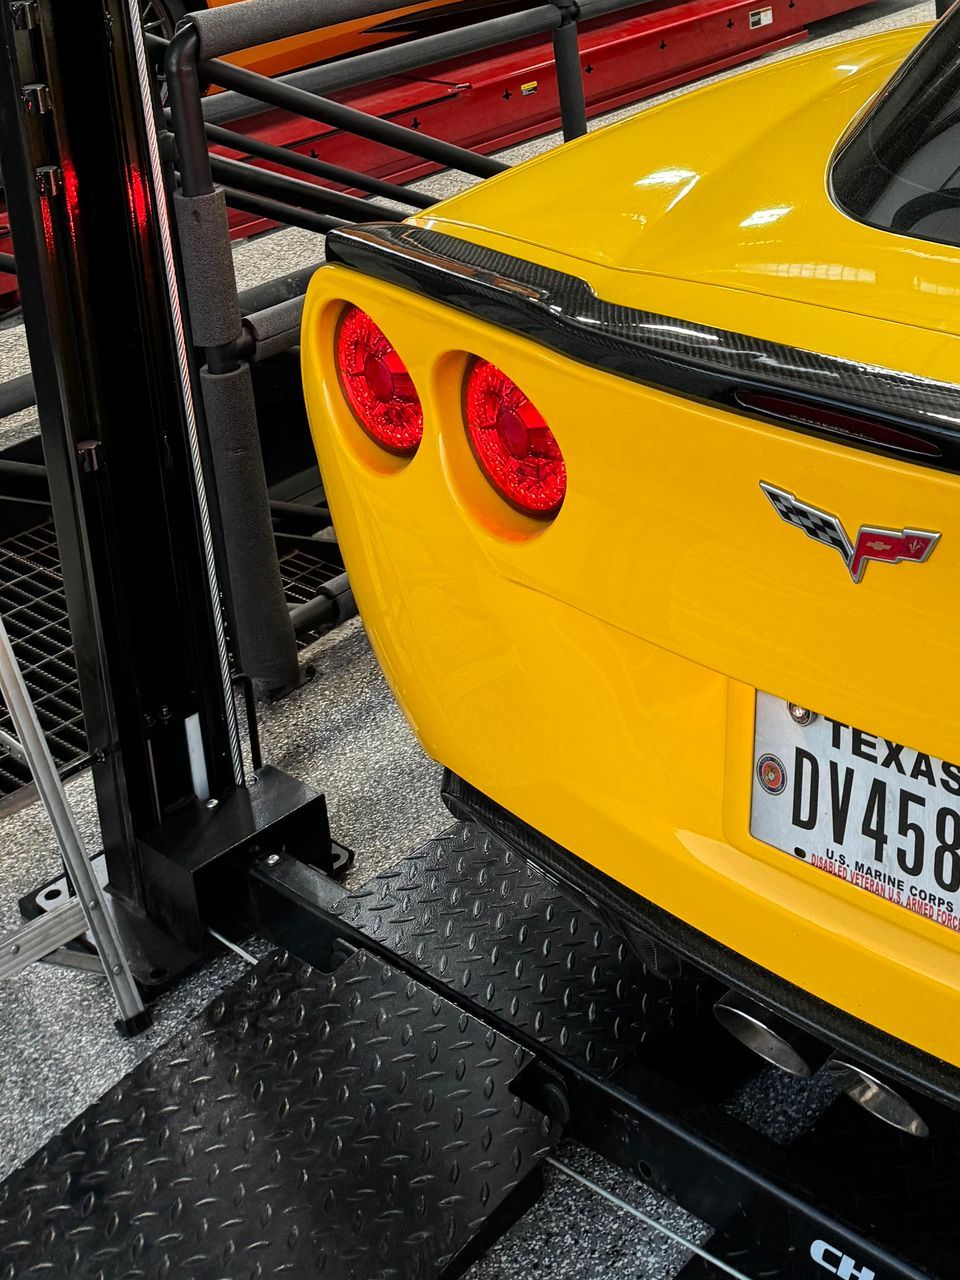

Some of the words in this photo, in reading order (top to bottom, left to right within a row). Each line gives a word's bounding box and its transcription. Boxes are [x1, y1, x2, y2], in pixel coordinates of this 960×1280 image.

[810, 853, 847, 880] DISABLED
[850, 869, 886, 901] VETERAN
[888, 887, 903, 907] U.S.
[905, 895, 934, 919] ARMED
[826, 848, 850, 867] U.S.
[855, 860, 905, 892] MARINE
[909, 885, 954, 913] CORPS
